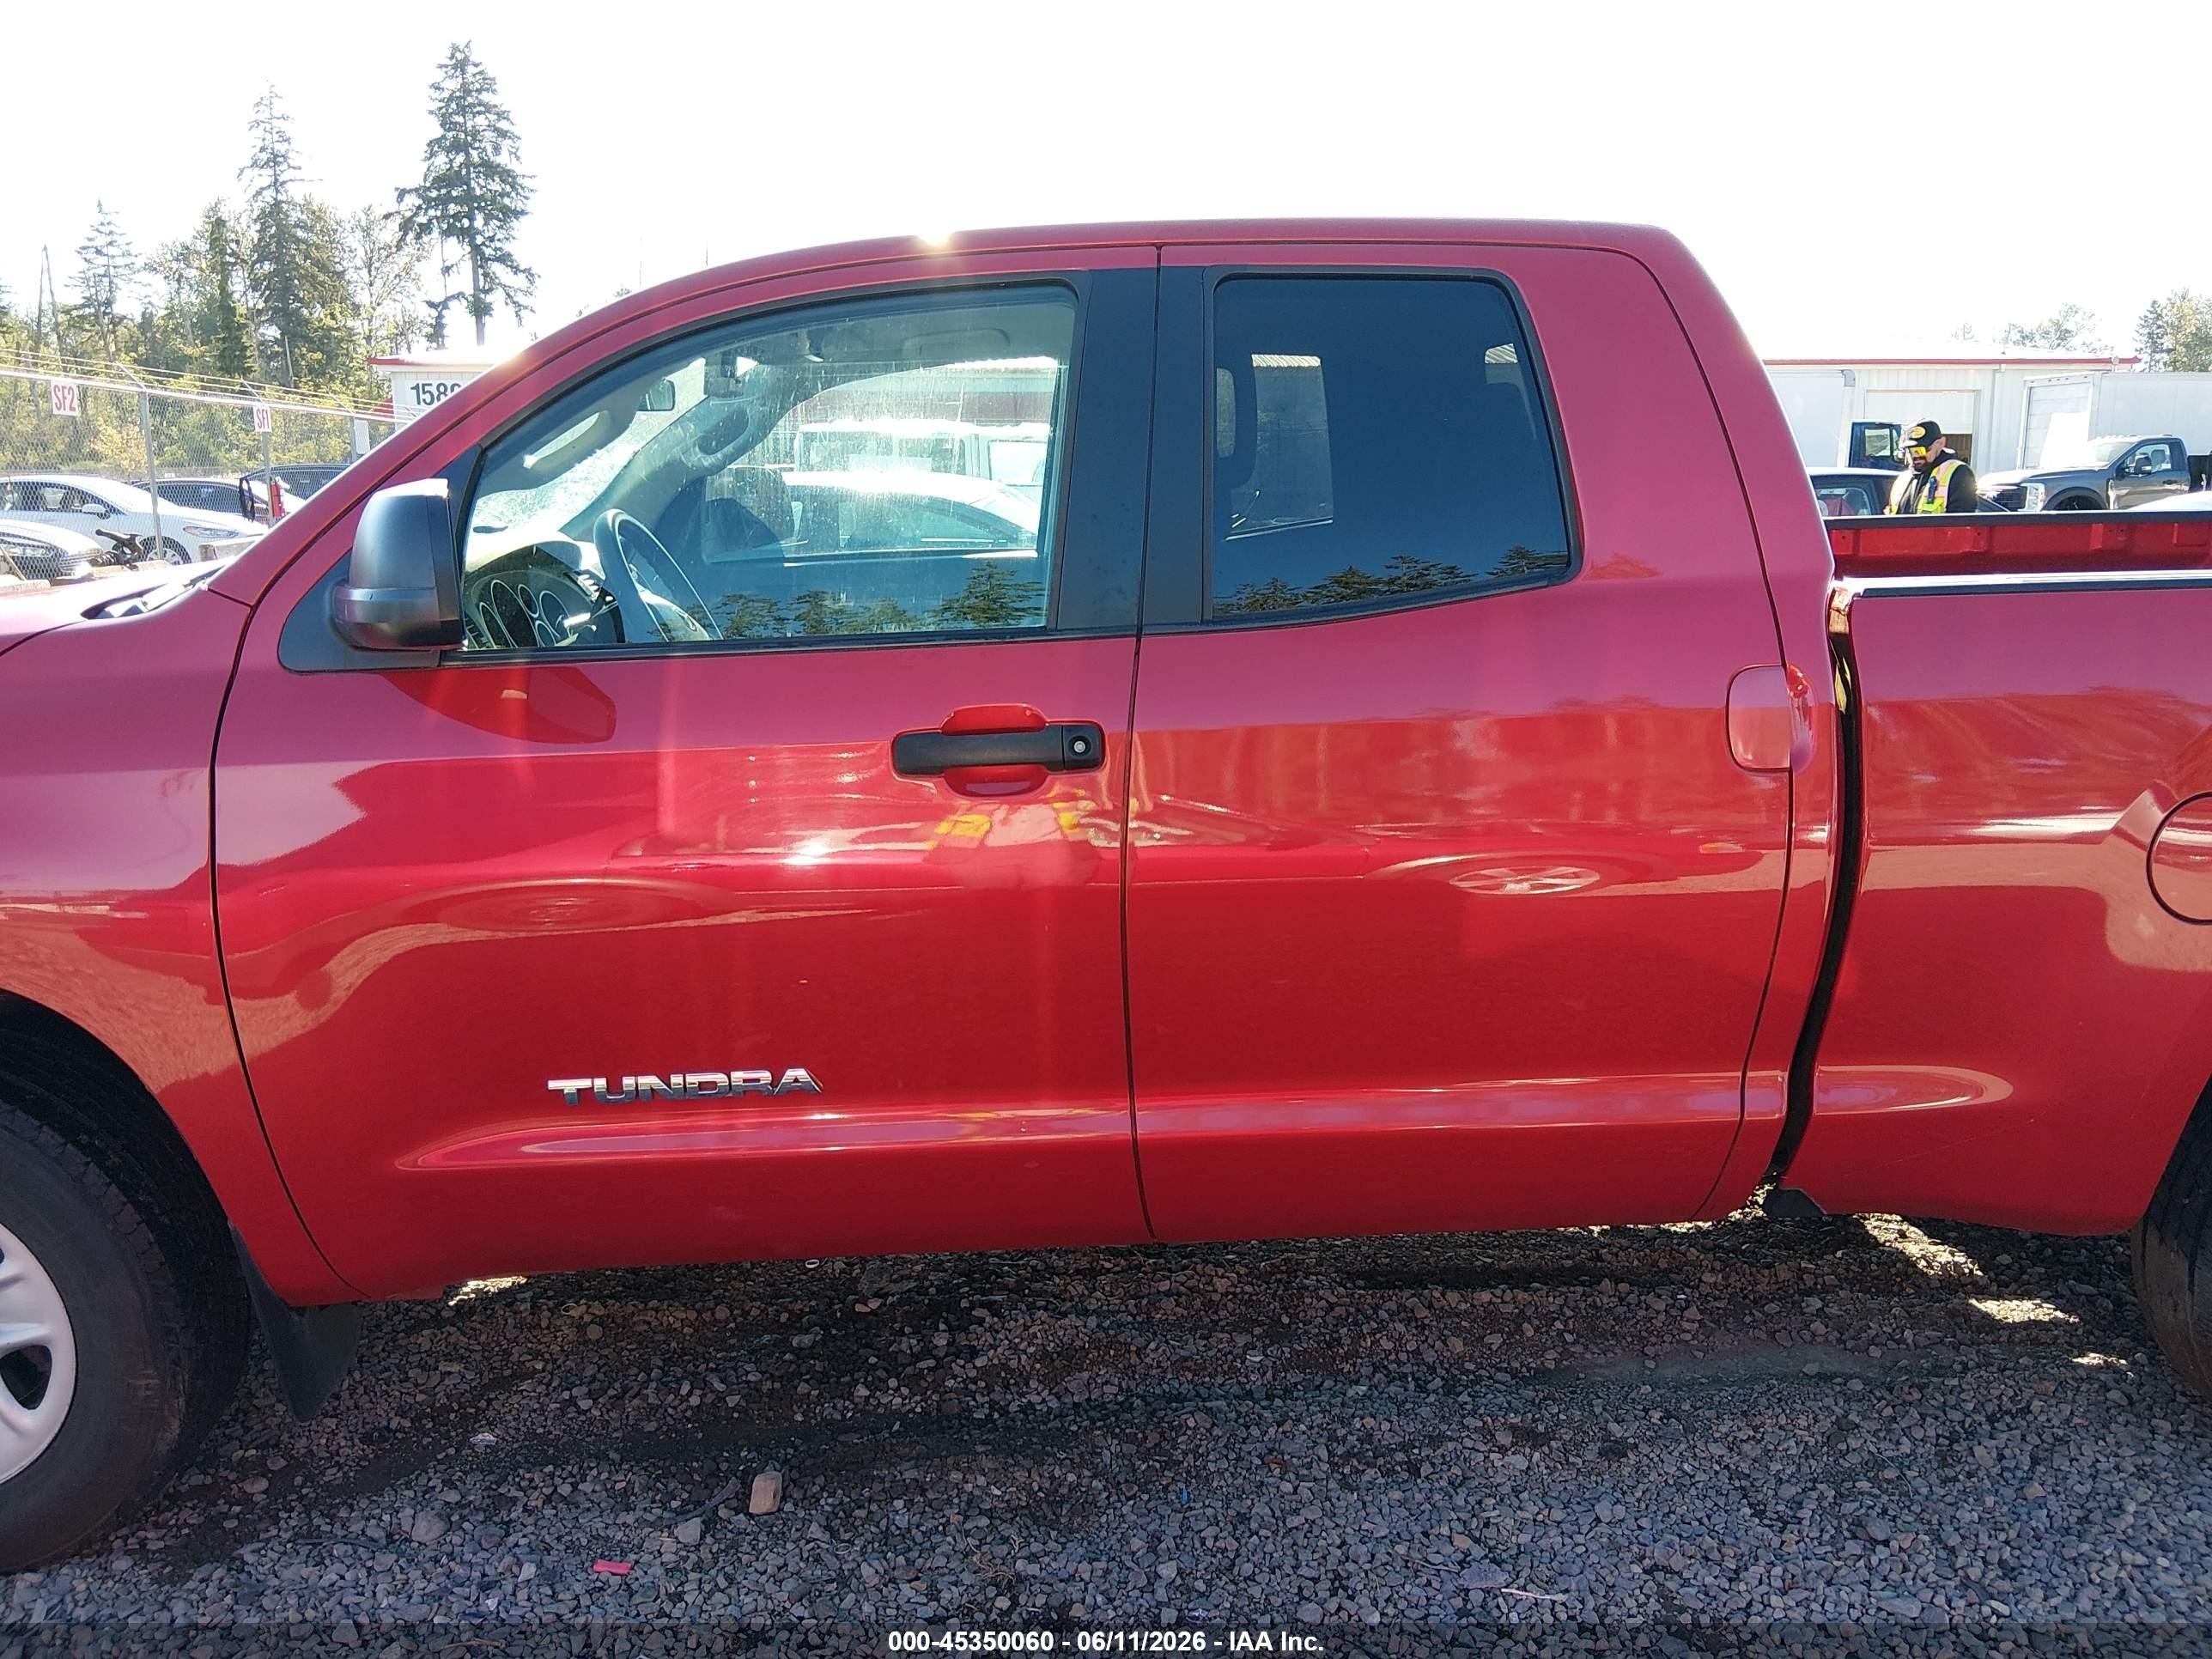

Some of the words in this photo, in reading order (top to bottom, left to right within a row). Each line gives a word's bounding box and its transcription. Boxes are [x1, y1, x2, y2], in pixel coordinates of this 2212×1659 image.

[53, 384, 76, 412] SF2
[256, 408, 270, 429] SF1
[547, 1067, 824, 1106] TUNDRA
